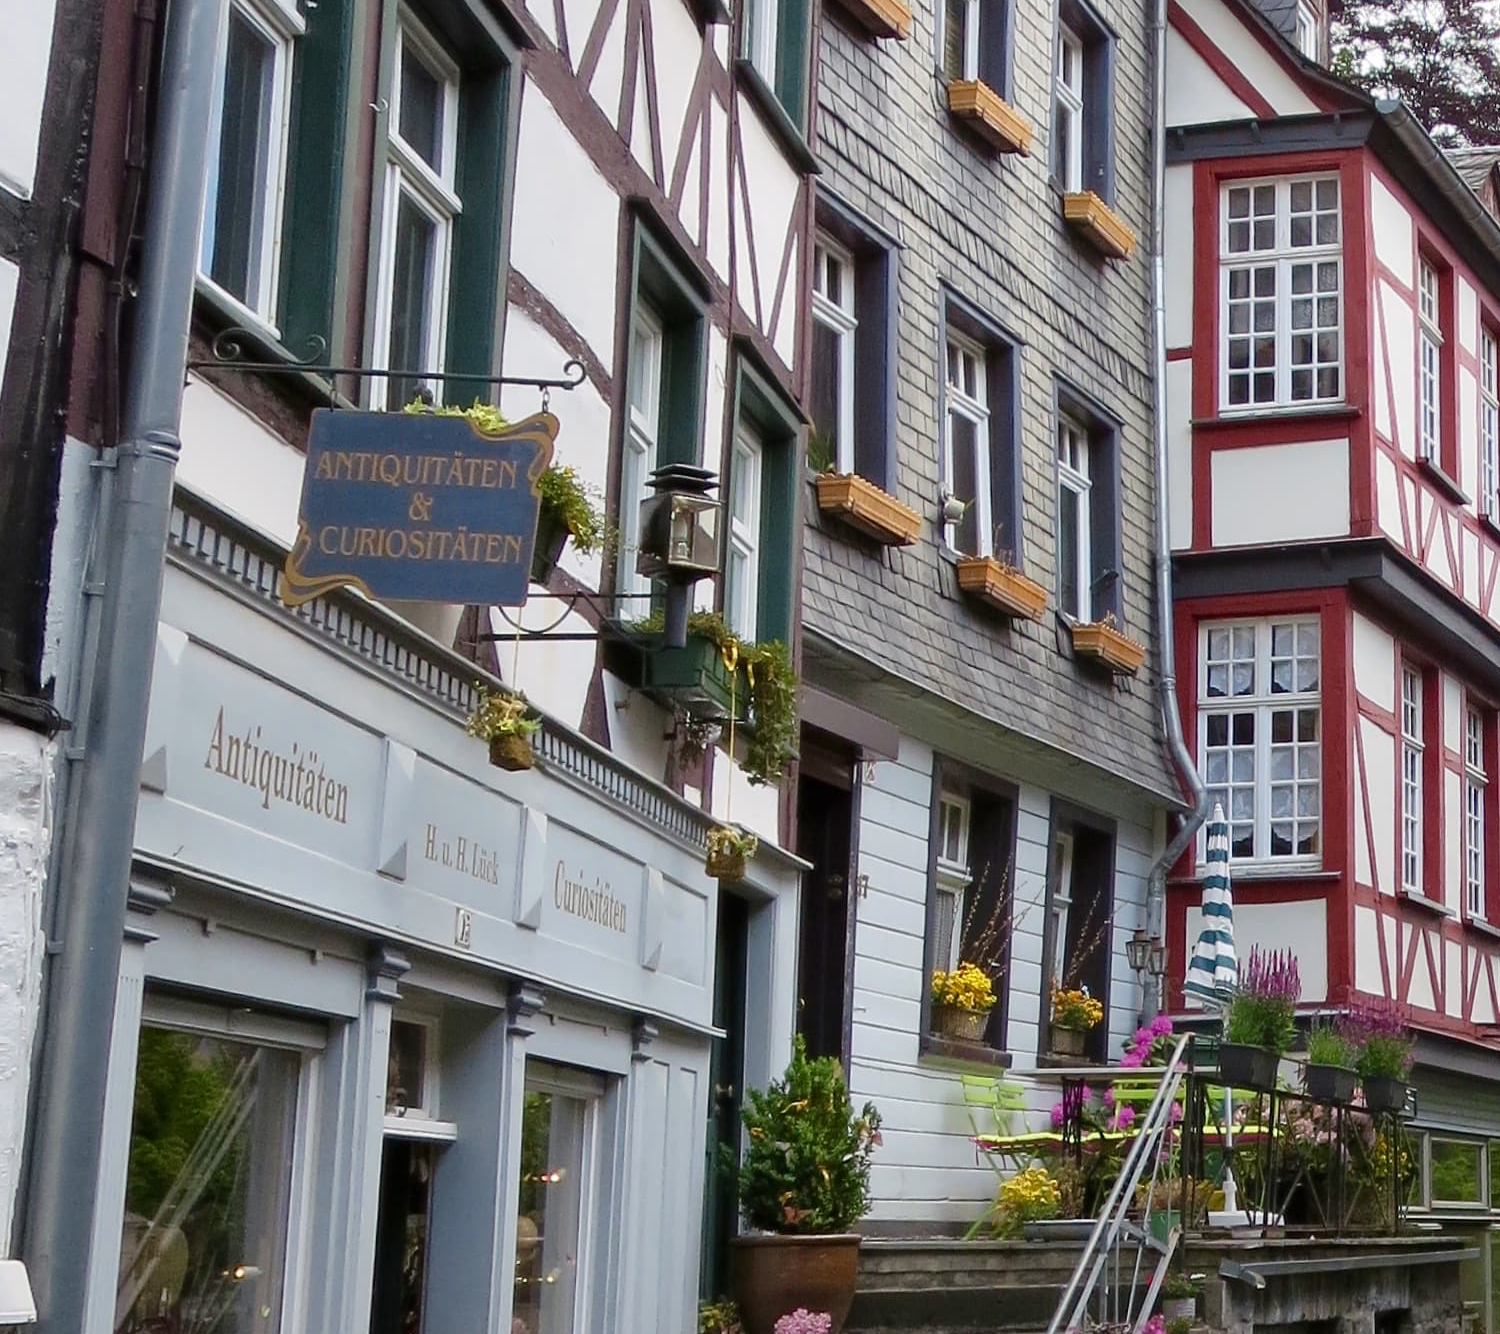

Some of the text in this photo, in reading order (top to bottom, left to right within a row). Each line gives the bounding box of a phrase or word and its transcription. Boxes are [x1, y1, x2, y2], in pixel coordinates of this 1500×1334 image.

[314, 450, 518, 489] ANTIQUITÄTEN
[408, 491, 433, 522] &
[319, 526, 523, 564] CURIOSITÄTEN
[204, 704, 348, 825] Antiquitäten
[424, 823, 499, 885] H. u. H. Lück
[554, 859, 627, 933] Curiositäten
